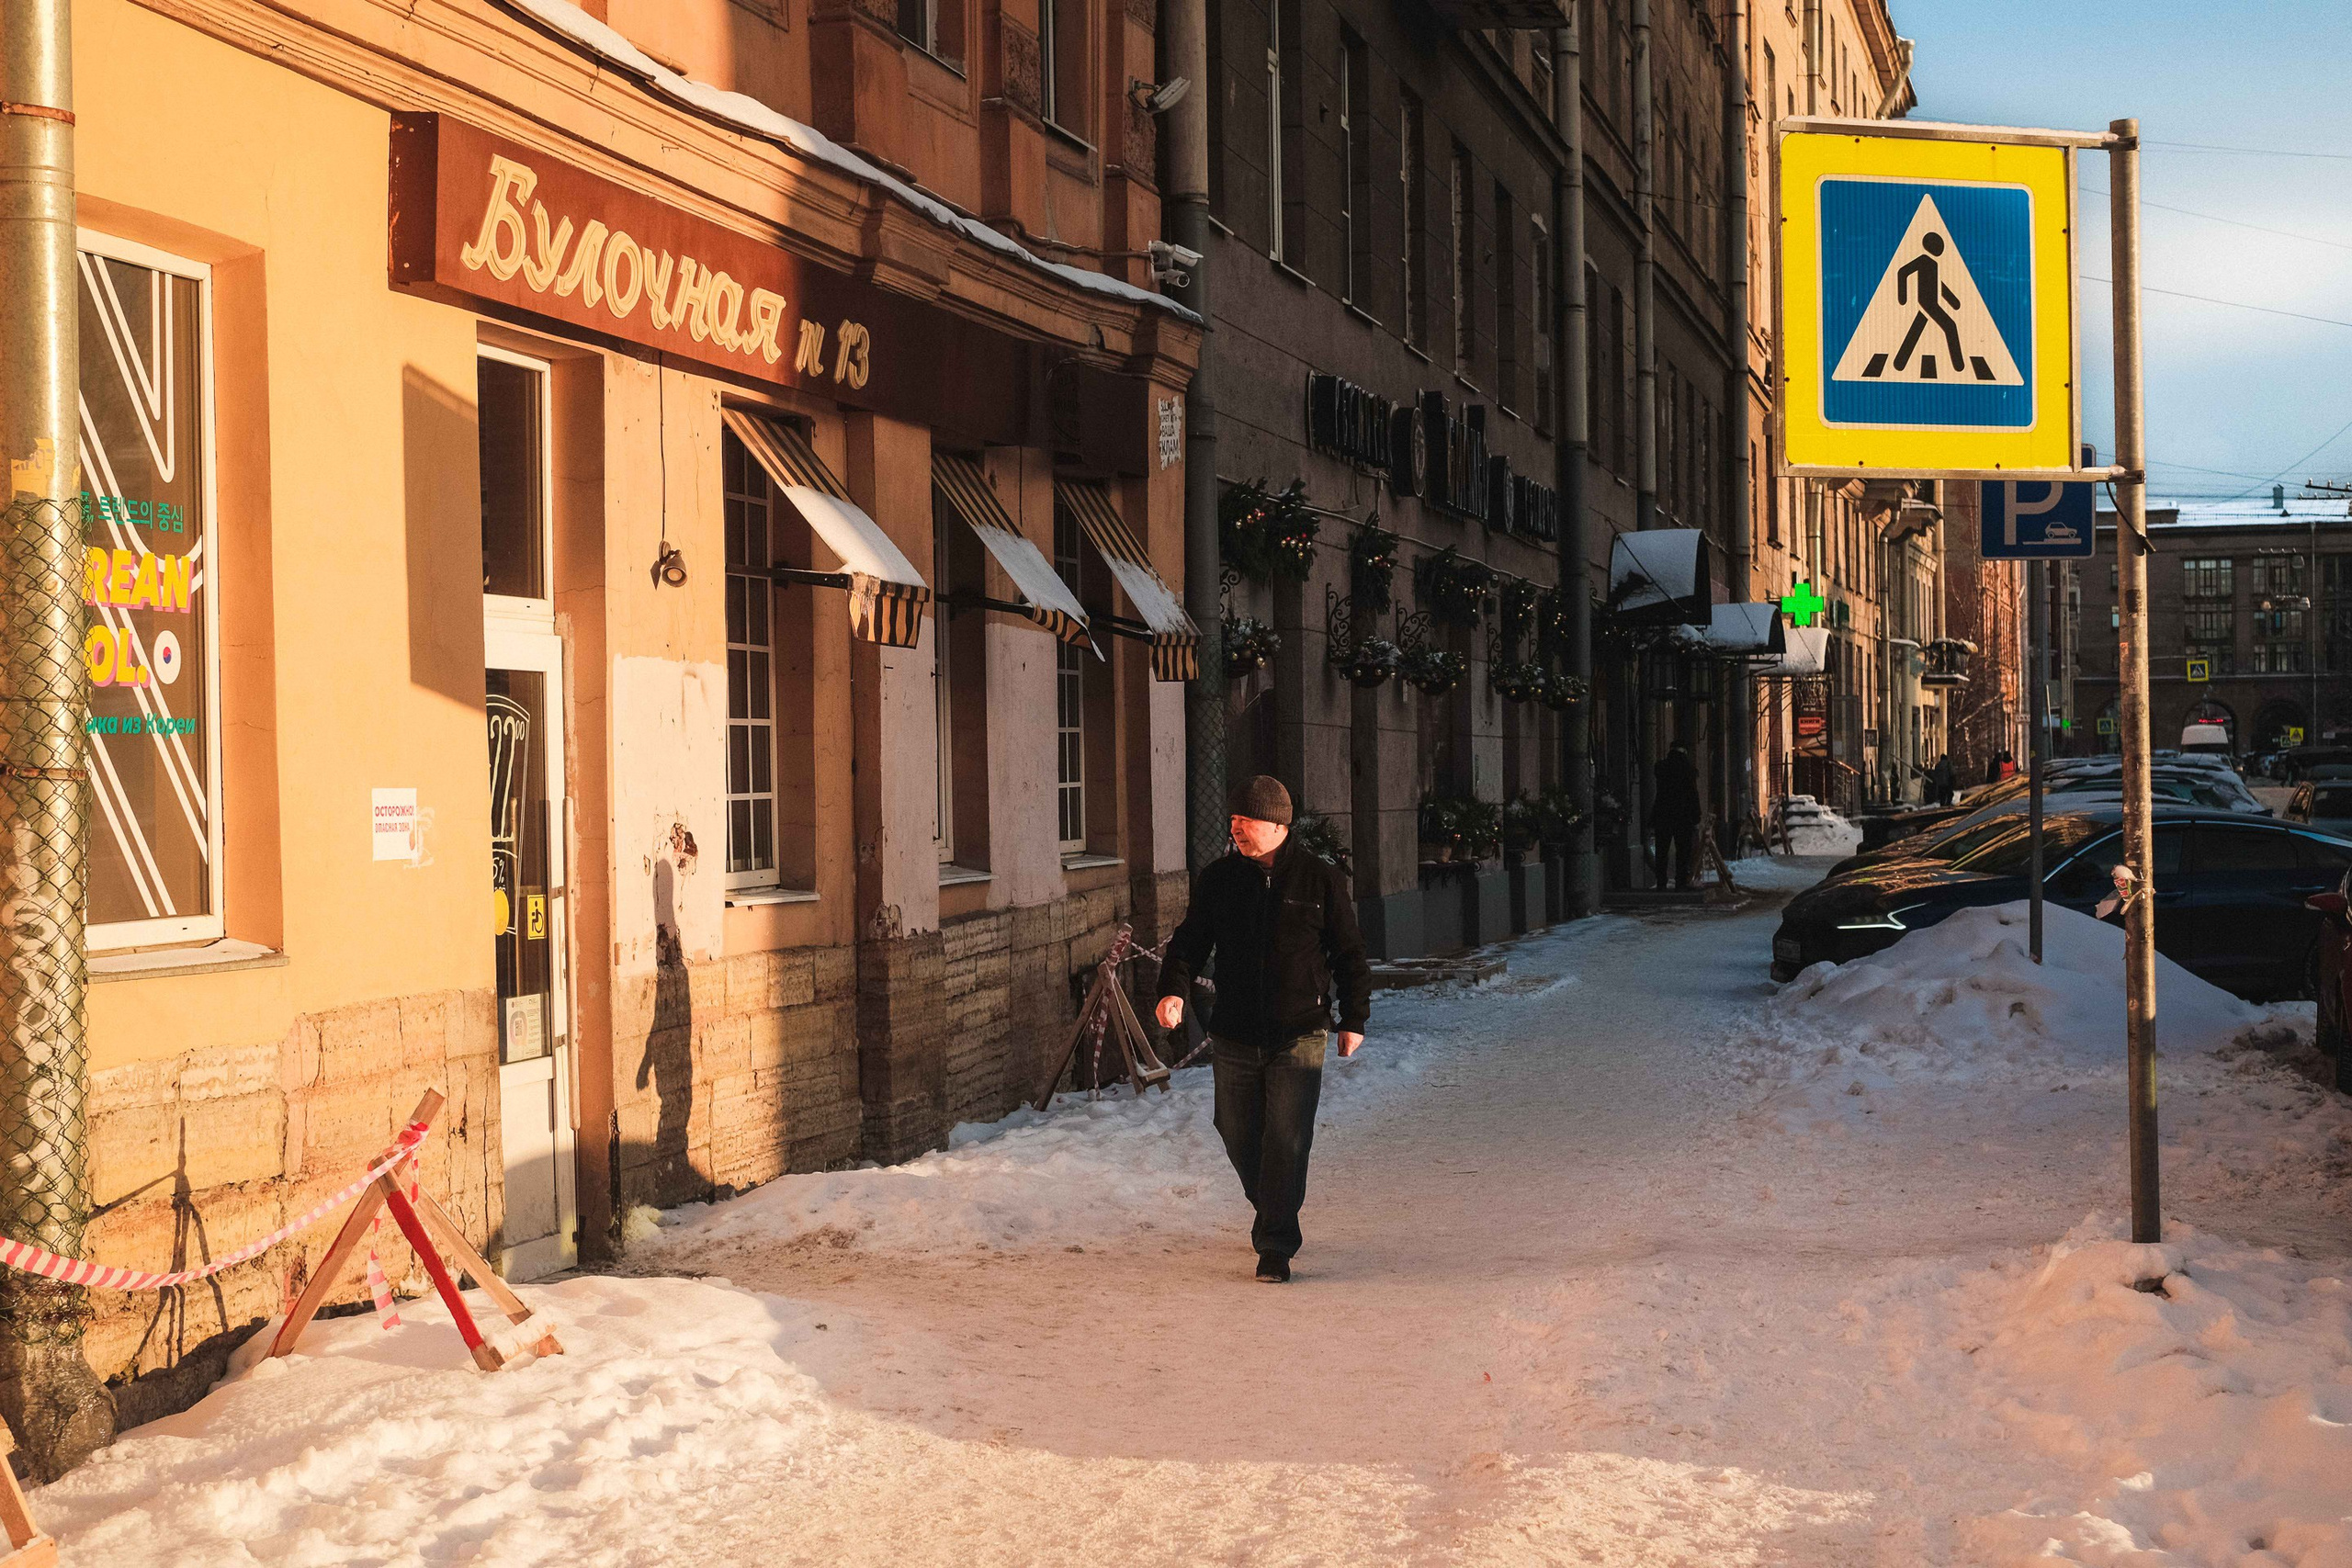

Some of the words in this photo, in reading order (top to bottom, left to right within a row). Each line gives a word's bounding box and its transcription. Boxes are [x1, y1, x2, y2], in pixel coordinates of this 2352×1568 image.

[460, 153, 786, 365] Булочная
[833, 319, 870, 390] 13
[98, 496, 153, 529] 트렌드의
[157, 502, 183, 533] 중심
[122, 716, 141, 734] из
[146, 713, 196, 739] Кореи
